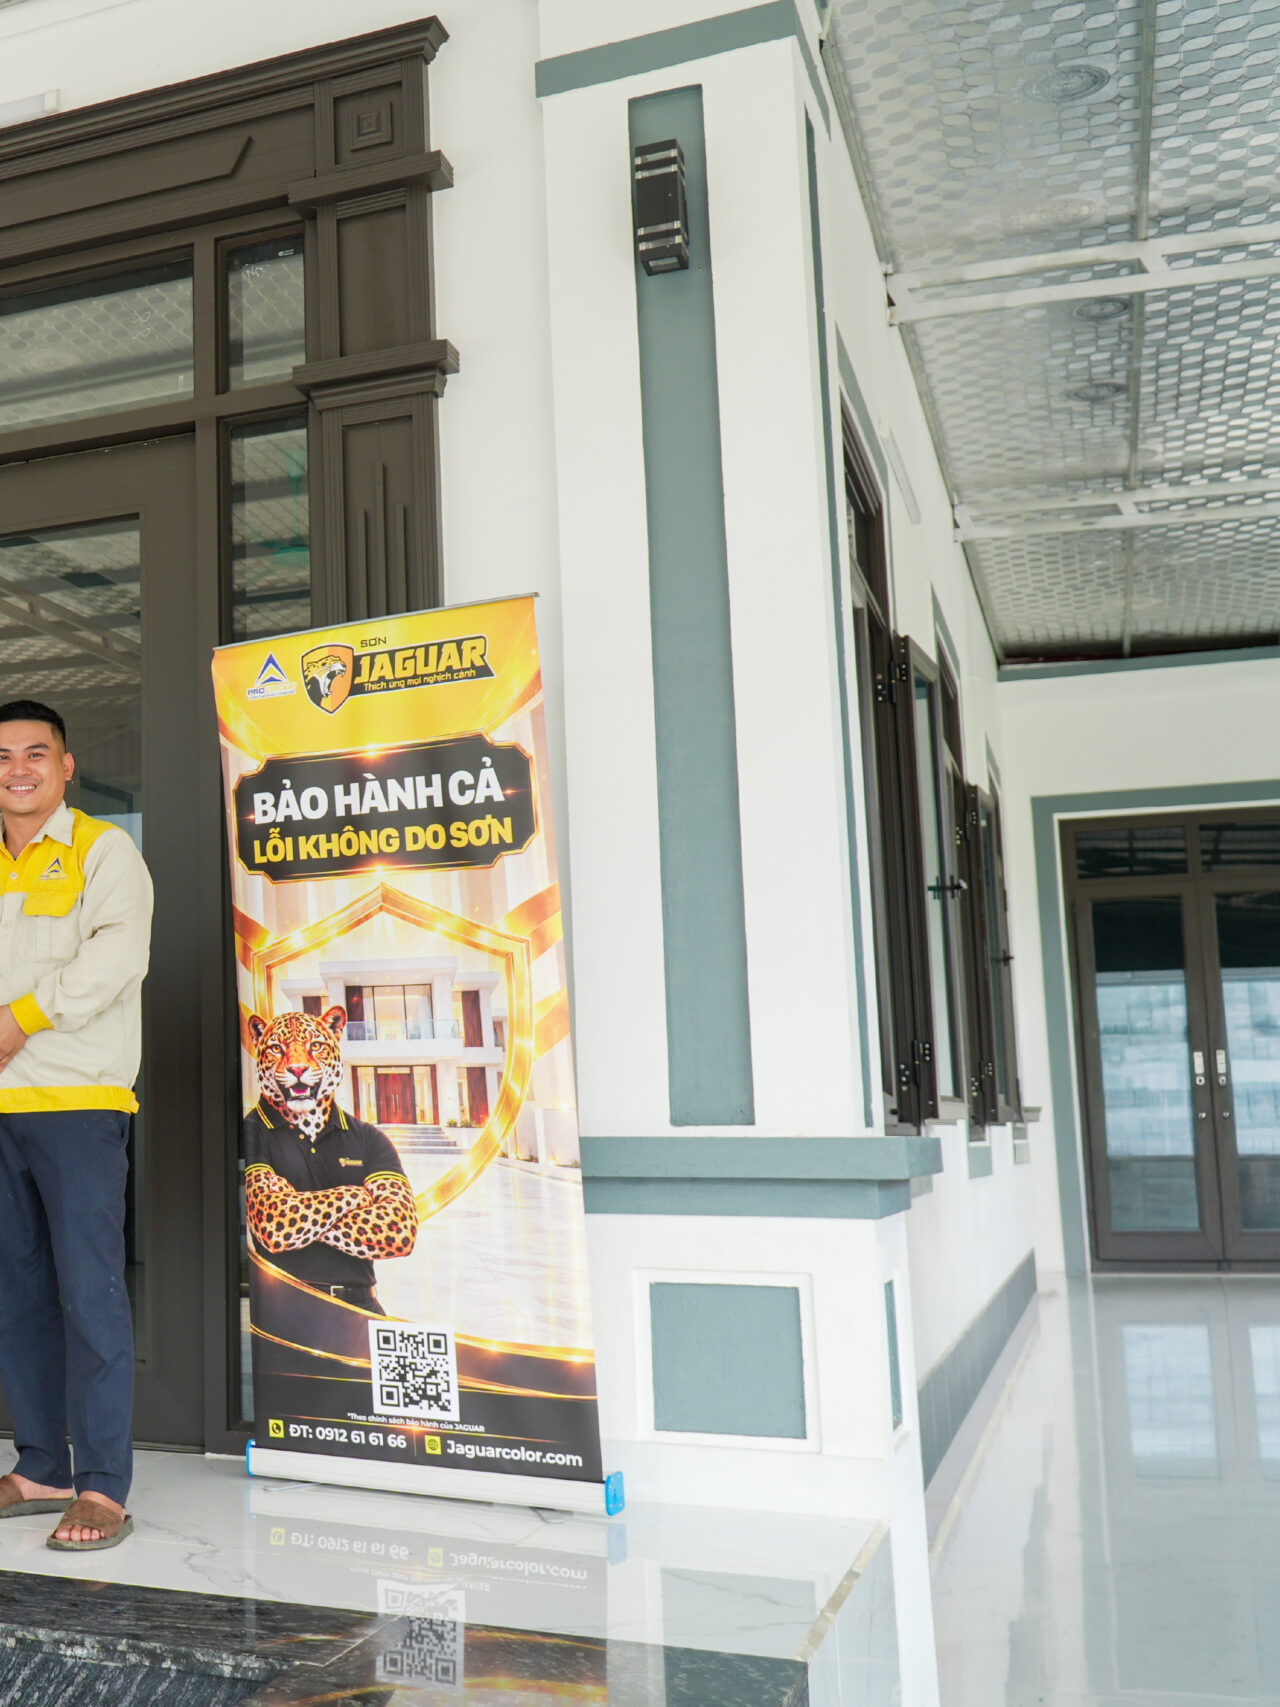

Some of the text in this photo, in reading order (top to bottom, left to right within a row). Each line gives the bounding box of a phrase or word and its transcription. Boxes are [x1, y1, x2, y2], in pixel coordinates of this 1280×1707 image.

[360, 636, 387, 648] SƠN
[353, 637, 486, 684] JAGUAR
[247, 687, 265, 696] PRO
[253, 756, 505, 825] BẢO HÀNH CẢ
[253, 814, 513, 864] LỖI KHÔNG DO SƠN
[289, 1425, 407, 1448] ĐT: 0912 61 61 66
[454, 1423, 485, 1433] JAGUAR
[446, 1440, 583, 1467] Jaguarcolor.com
